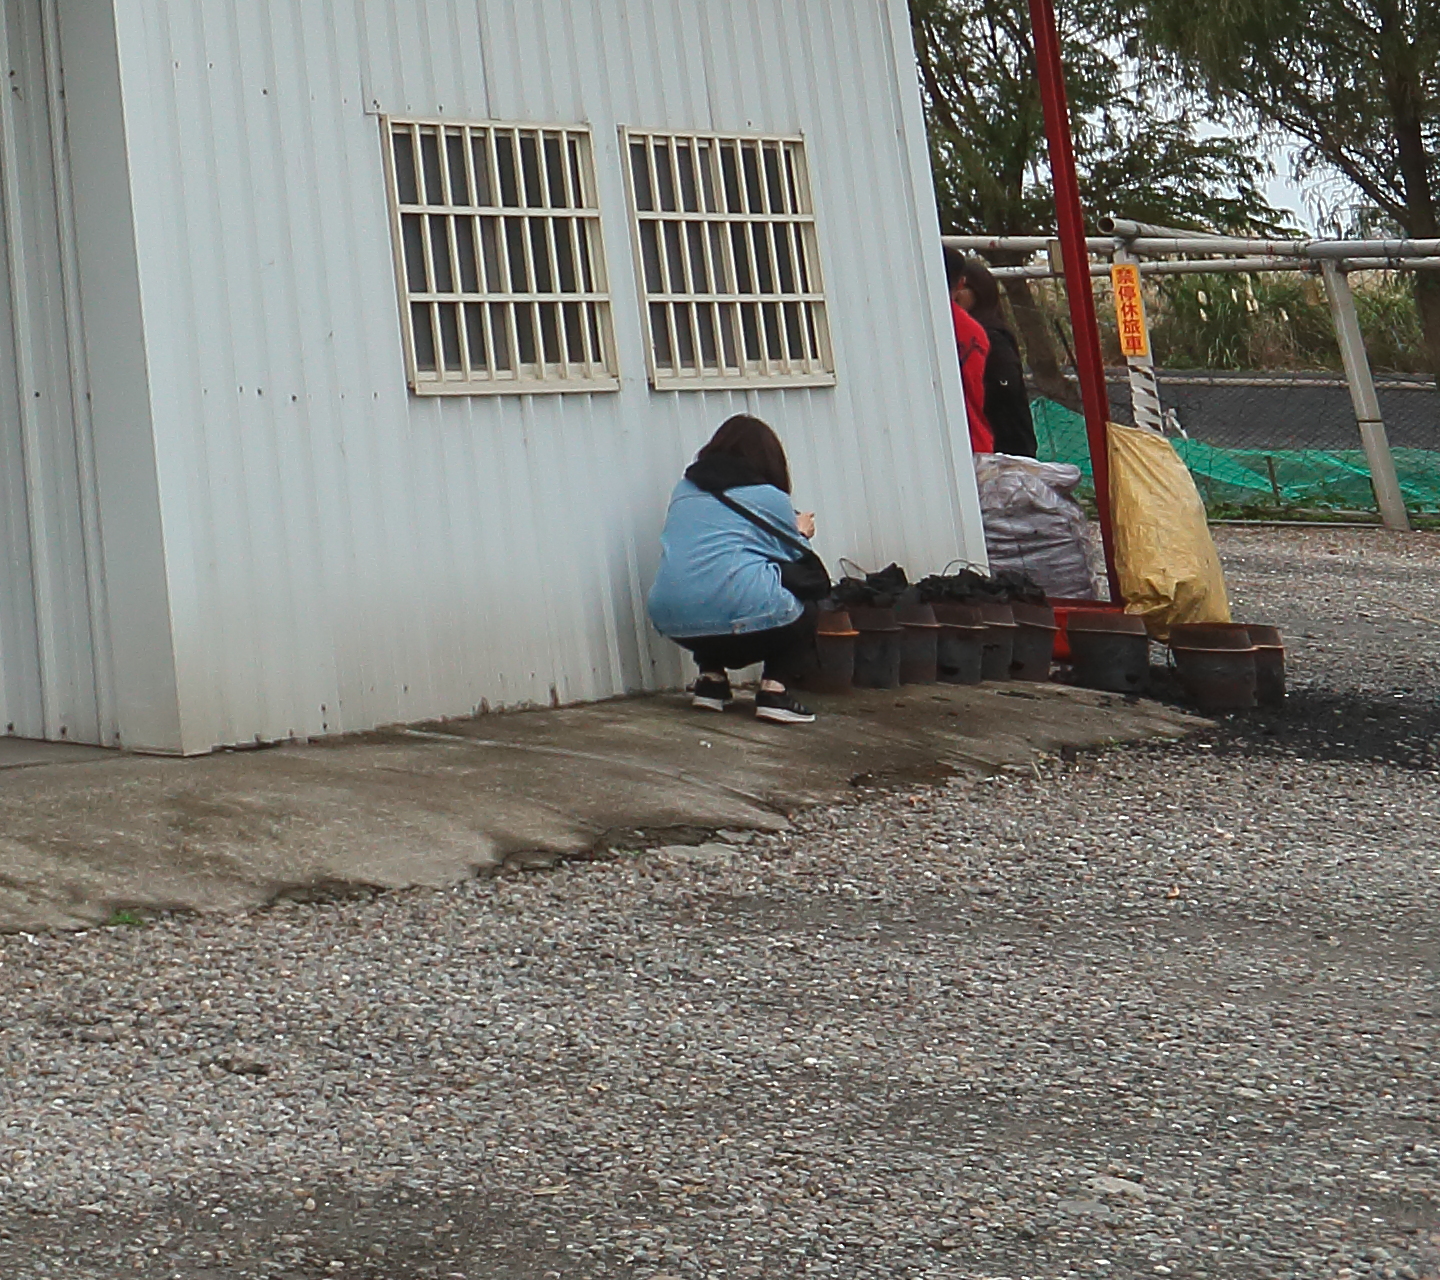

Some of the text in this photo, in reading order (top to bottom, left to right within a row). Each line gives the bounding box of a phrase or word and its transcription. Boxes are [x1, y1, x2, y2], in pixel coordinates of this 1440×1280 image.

[1115, 268, 1144, 355] 禁停休旅車
